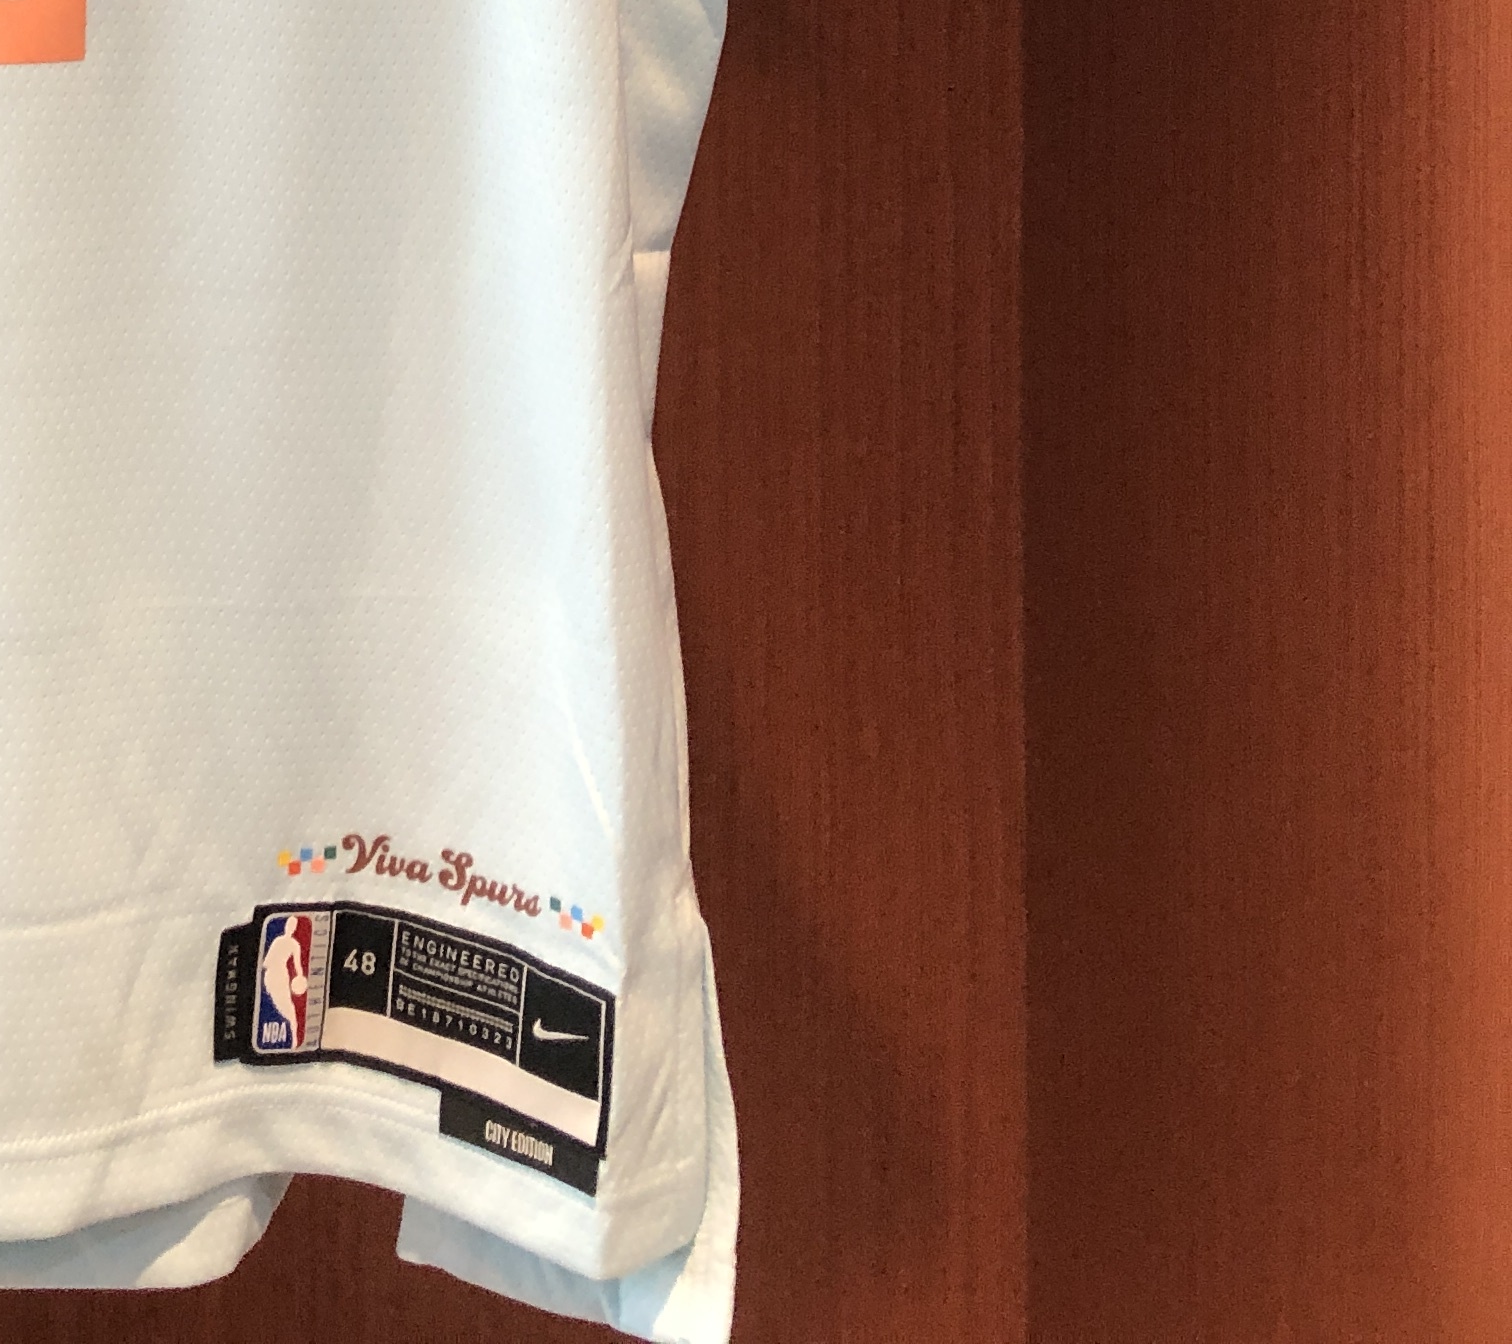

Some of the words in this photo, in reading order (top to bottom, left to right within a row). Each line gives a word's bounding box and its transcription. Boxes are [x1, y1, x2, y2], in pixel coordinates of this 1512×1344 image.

[341, 833, 433, 884] Viva
[438, 848, 542, 917] Spurs
[342, 948, 377, 976] 48
[401, 930, 520, 984] ENGINEERED
[223, 944, 239, 1040] SWINGMAN
[261, 1021, 287, 1044] NBA
[485, 1119, 510, 1149] CITY
[511, 1130, 554, 1166] EDITION
